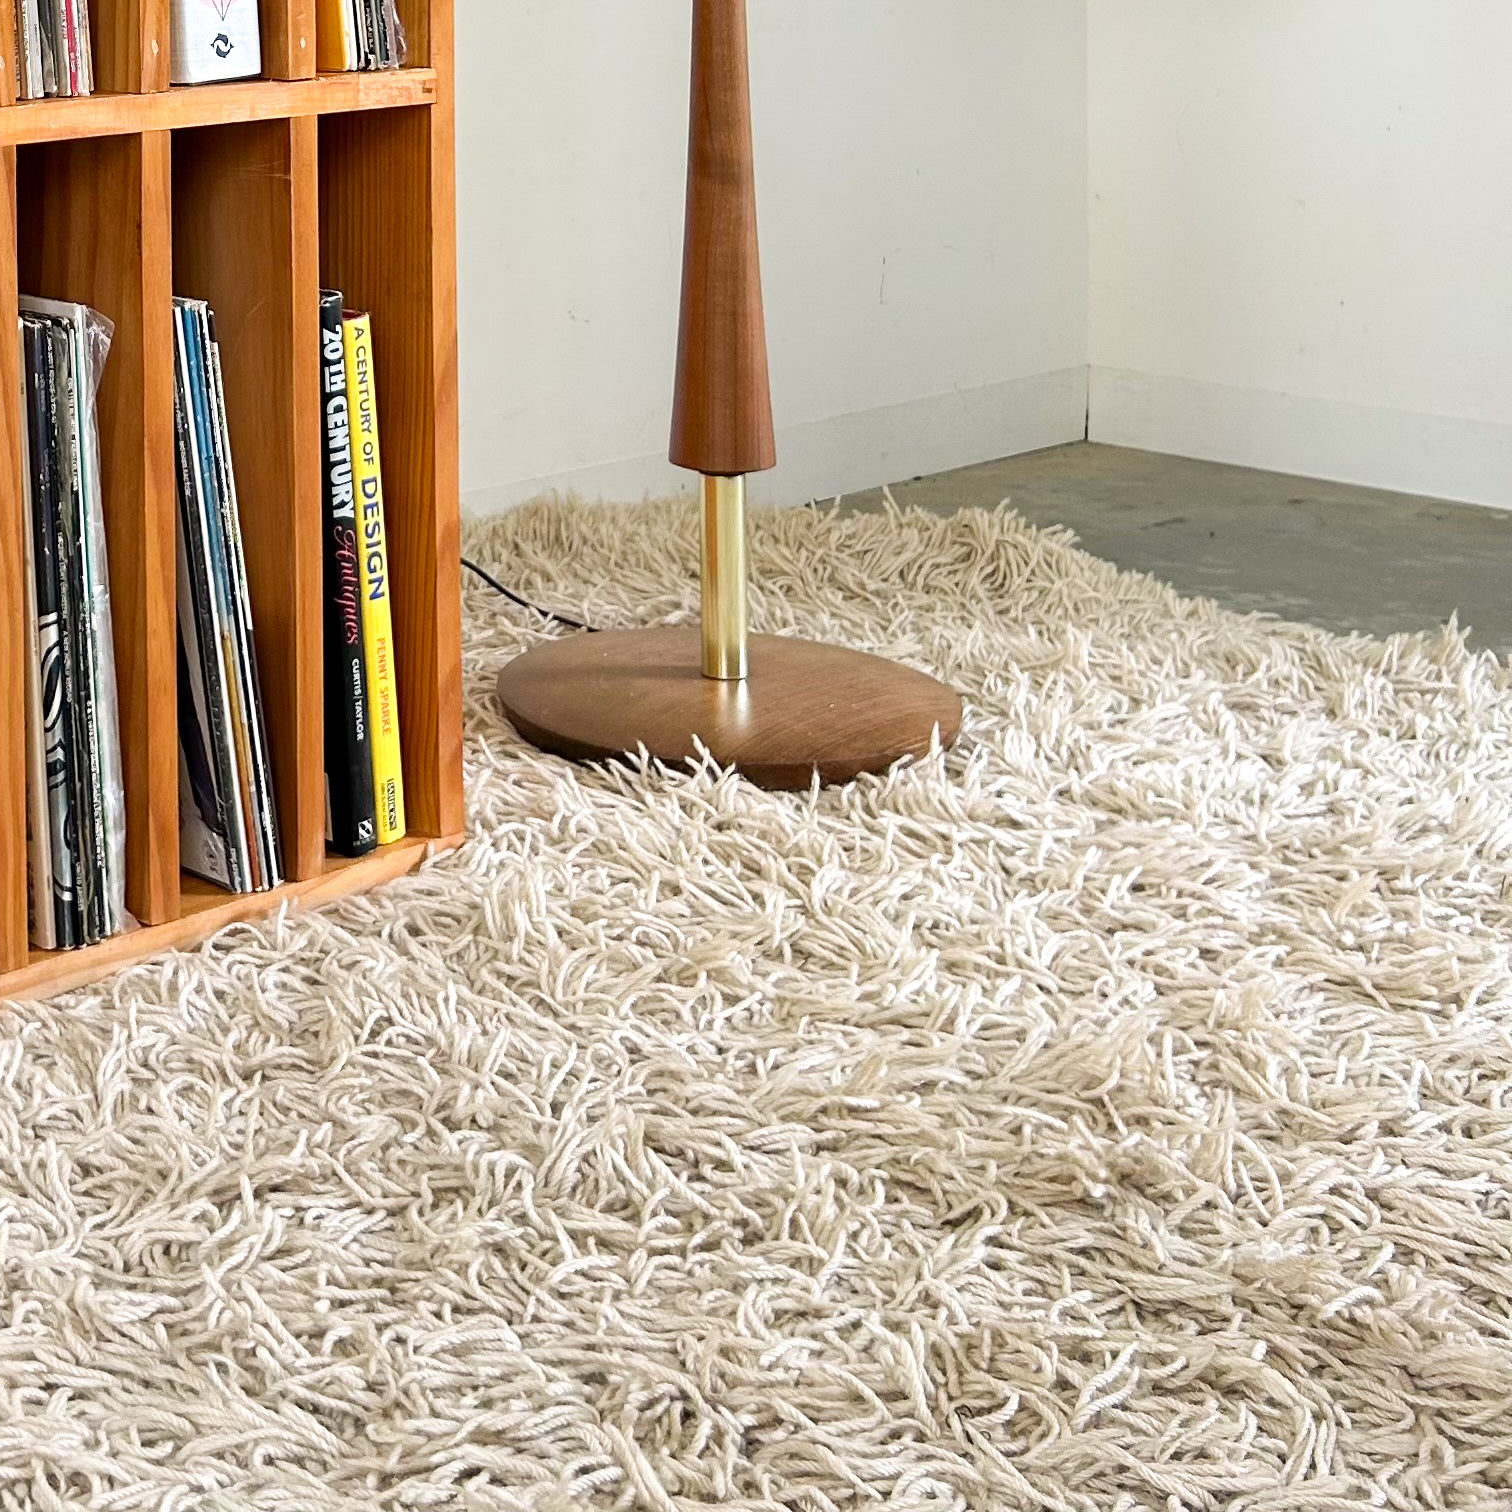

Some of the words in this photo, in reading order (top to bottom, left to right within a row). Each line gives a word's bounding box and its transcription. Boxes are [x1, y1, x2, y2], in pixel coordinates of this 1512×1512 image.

[353, 326, 366, 341] A
[355, 345, 373, 434] CENTURY
[327, 395, 355, 519] CENTURY
[362, 441, 375, 467] OF
[361, 477, 386, 601] DESIGN
[333, 524, 359, 645] Antiques
[376, 637, 387, 681] PENNY
[379, 686, 392, 736] SPARKE
